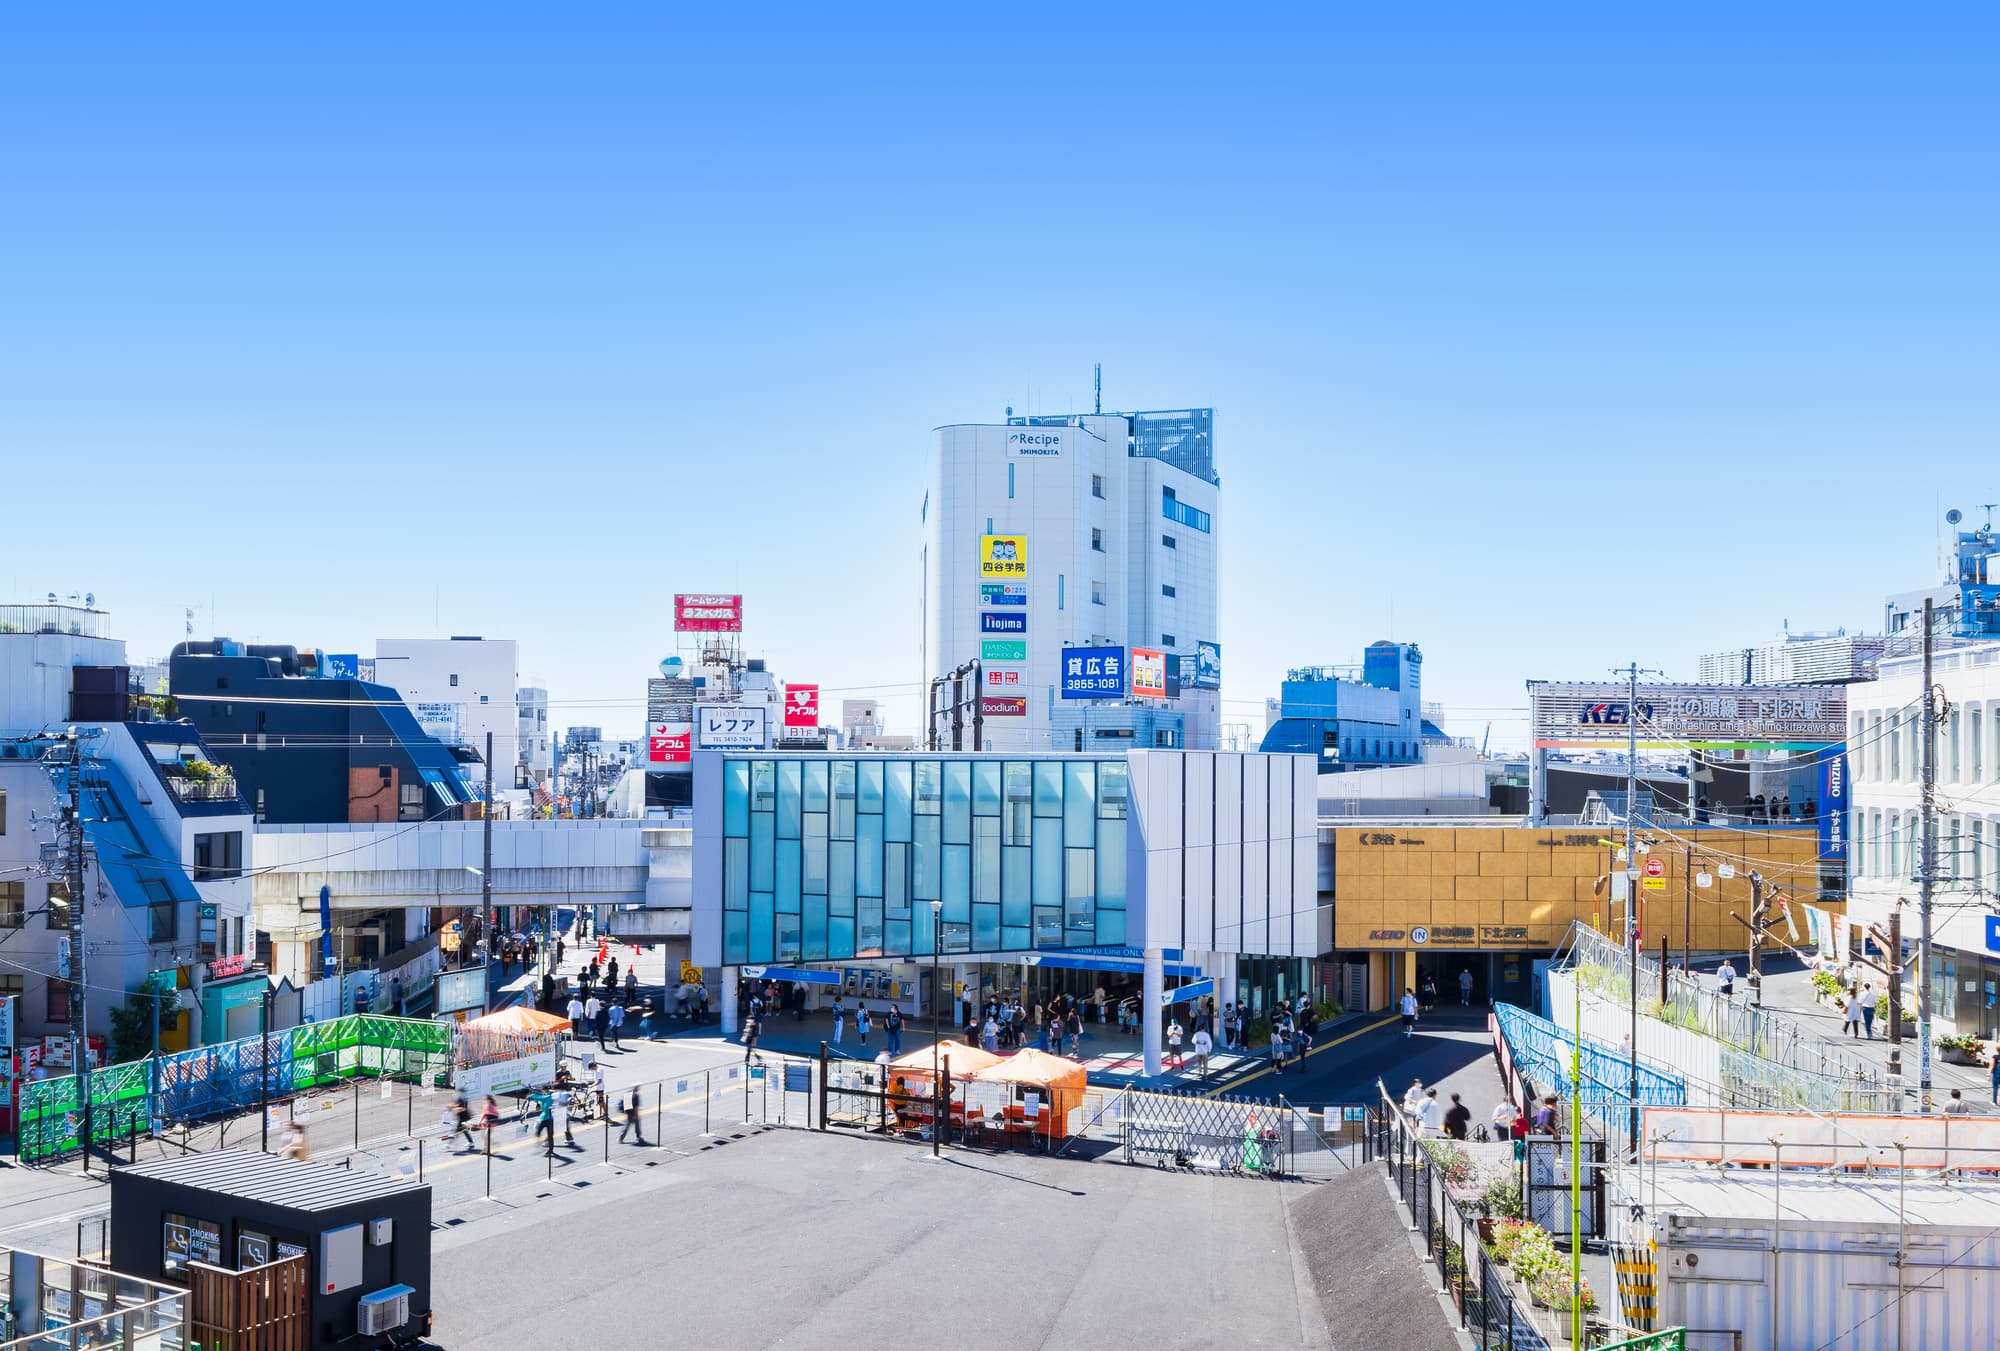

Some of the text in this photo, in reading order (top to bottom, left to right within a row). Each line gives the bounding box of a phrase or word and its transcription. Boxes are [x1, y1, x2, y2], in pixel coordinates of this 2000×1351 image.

[1019, 433, 1060, 447] Recipe
[983, 562, 1025, 573] 四谷学院
[685, 596, 732, 605] ゲームセンター
[1068, 656, 1119, 676] 貸広告
[786, 706, 817, 716] アイフル
[982, 702, 1020, 712] foodium
[1666, 696, 1823, 720] 井の頭線 下北沢駅
[655, 739, 684, 749] アコム
[1831, 757, 1841, 797] MIZUHO
[1414, 931, 1426, 940] IN
[1104, 949, 1121, 957] Line
[191, 1228, 220, 1243] SMOKING
[191, 1239, 209, 1250] AREA
